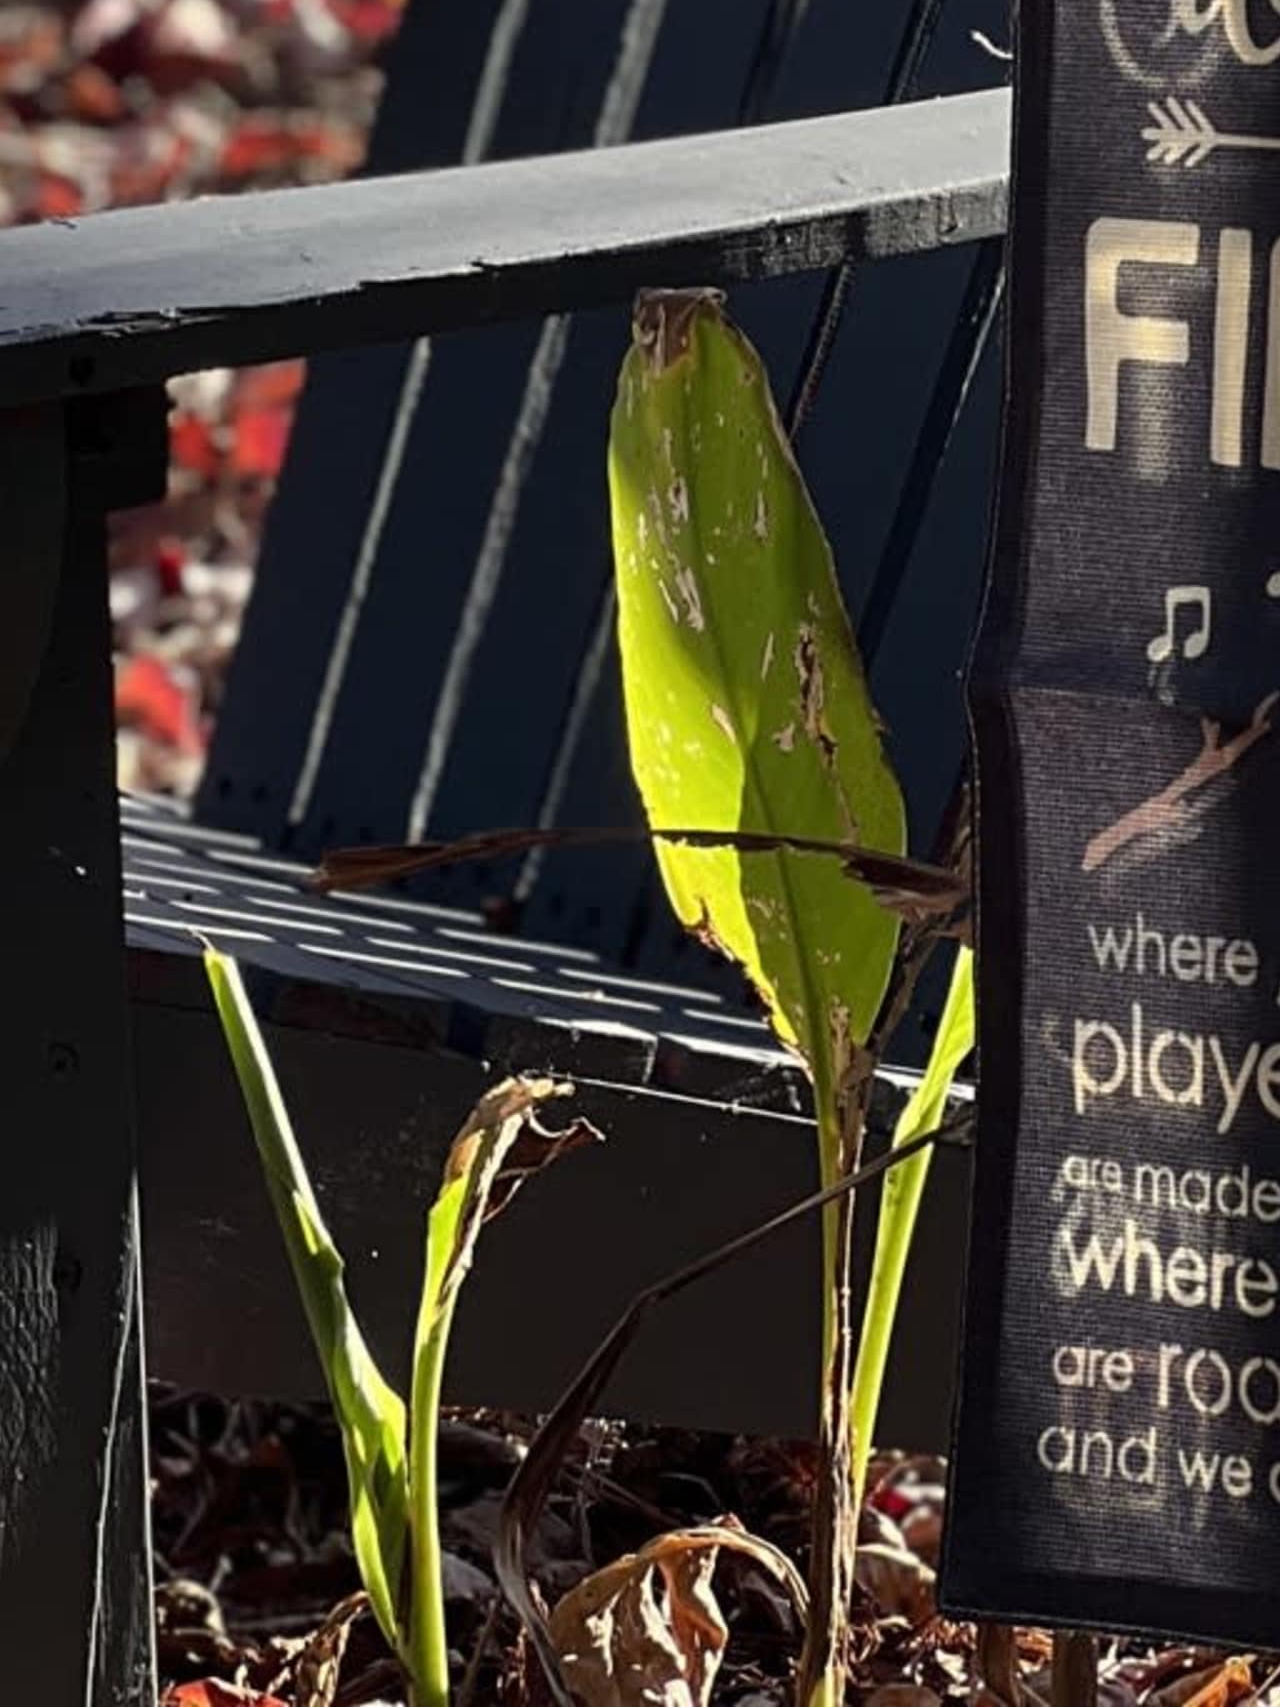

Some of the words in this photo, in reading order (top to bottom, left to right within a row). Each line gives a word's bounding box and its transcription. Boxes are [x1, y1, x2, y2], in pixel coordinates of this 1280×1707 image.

[1086, 916, 1259, 987] where
[1063, 1155, 1122, 1189] are
[1064, 1218, 1279, 1318] where
[1053, 1341, 1133, 1391] are
[1038, 1416, 1155, 1487] and
[1178, 1446, 1253, 1496] we
